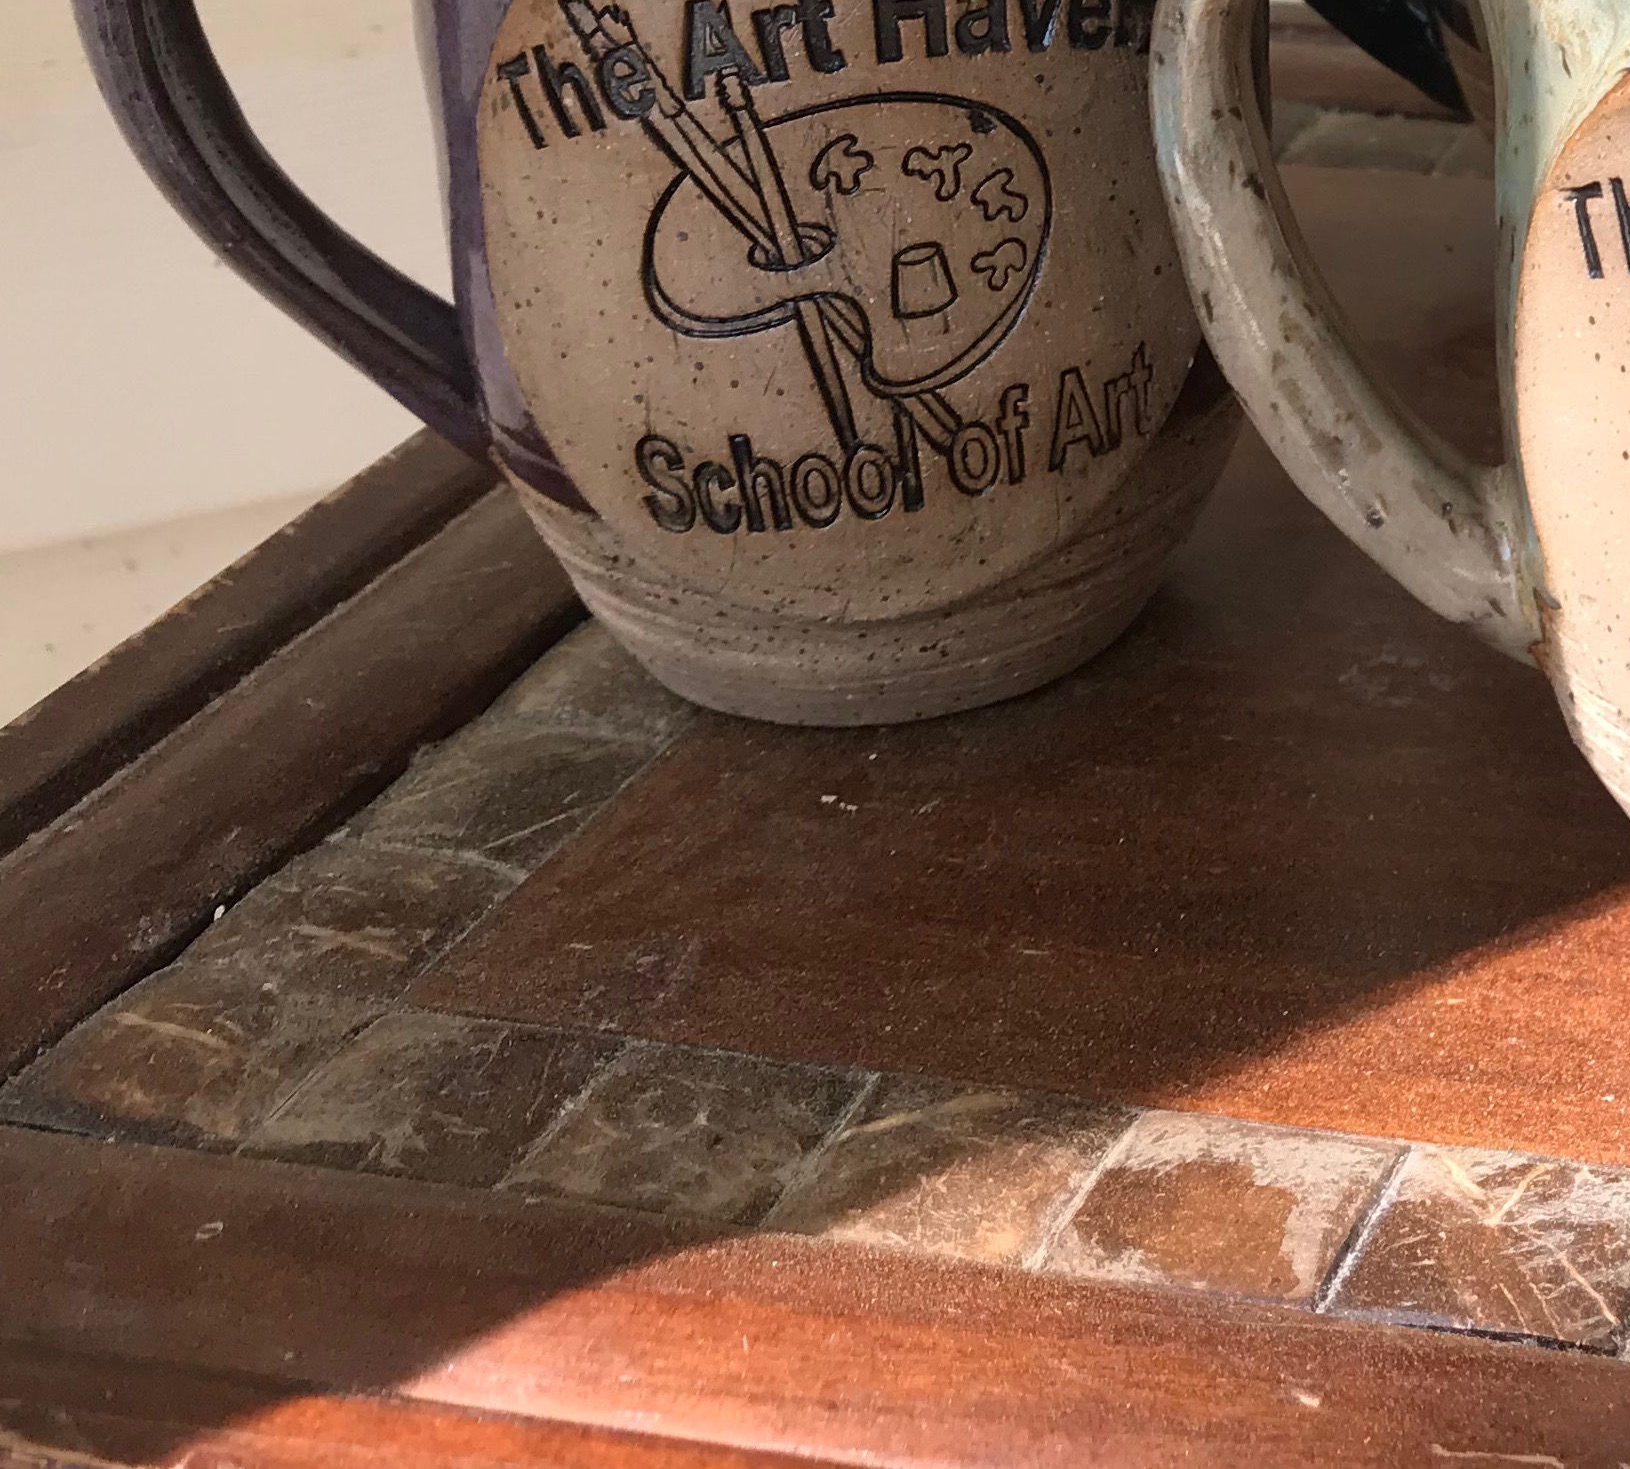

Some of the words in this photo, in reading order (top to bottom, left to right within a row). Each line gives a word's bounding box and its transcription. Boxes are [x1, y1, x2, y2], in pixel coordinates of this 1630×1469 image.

[496, 41, 656, 150] The
[634, 410, 925, 533] School
[947, 383, 1030, 497] of
[1048, 341, 1154, 471] Art
